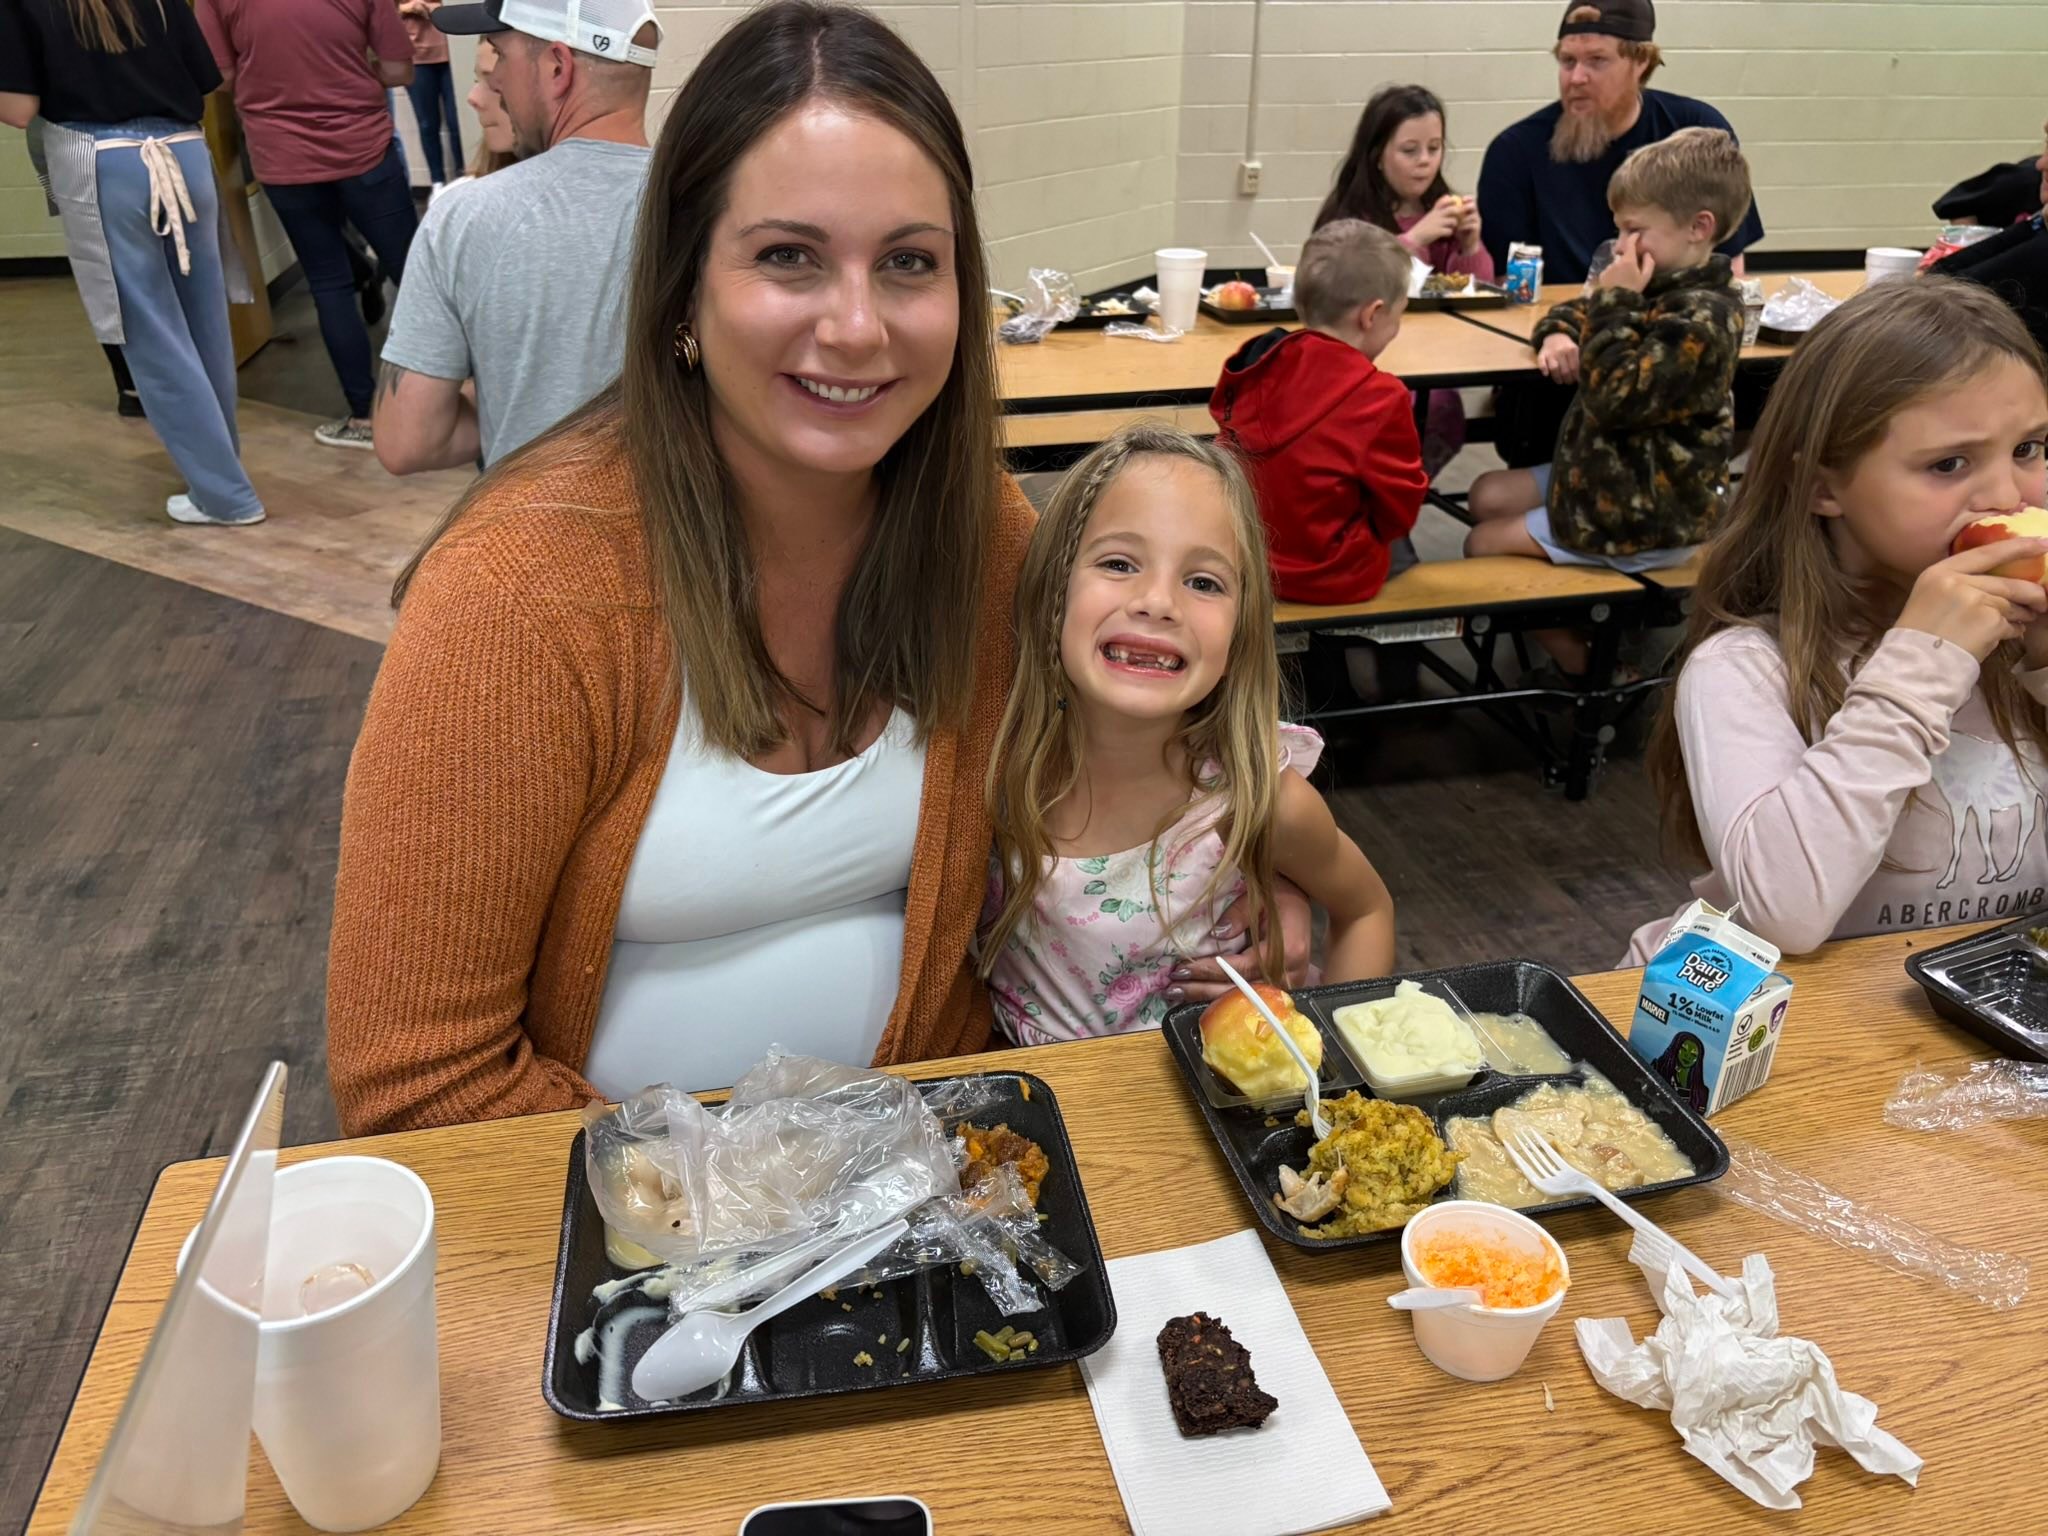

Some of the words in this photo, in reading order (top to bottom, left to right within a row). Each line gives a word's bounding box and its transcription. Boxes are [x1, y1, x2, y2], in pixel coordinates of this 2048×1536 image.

[1877, 887, 2045, 925] ABERCROMB
[1678, 965, 1716, 992] Pure
[1684, 952, 1729, 984] Dairy
[1641, 997, 1668, 1022] MARVEL
[1667, 992, 1694, 1015] 1%
[1695, 1003, 1724, 1021] Lowfat
[1694, 1011, 1712, 1024] Milk
